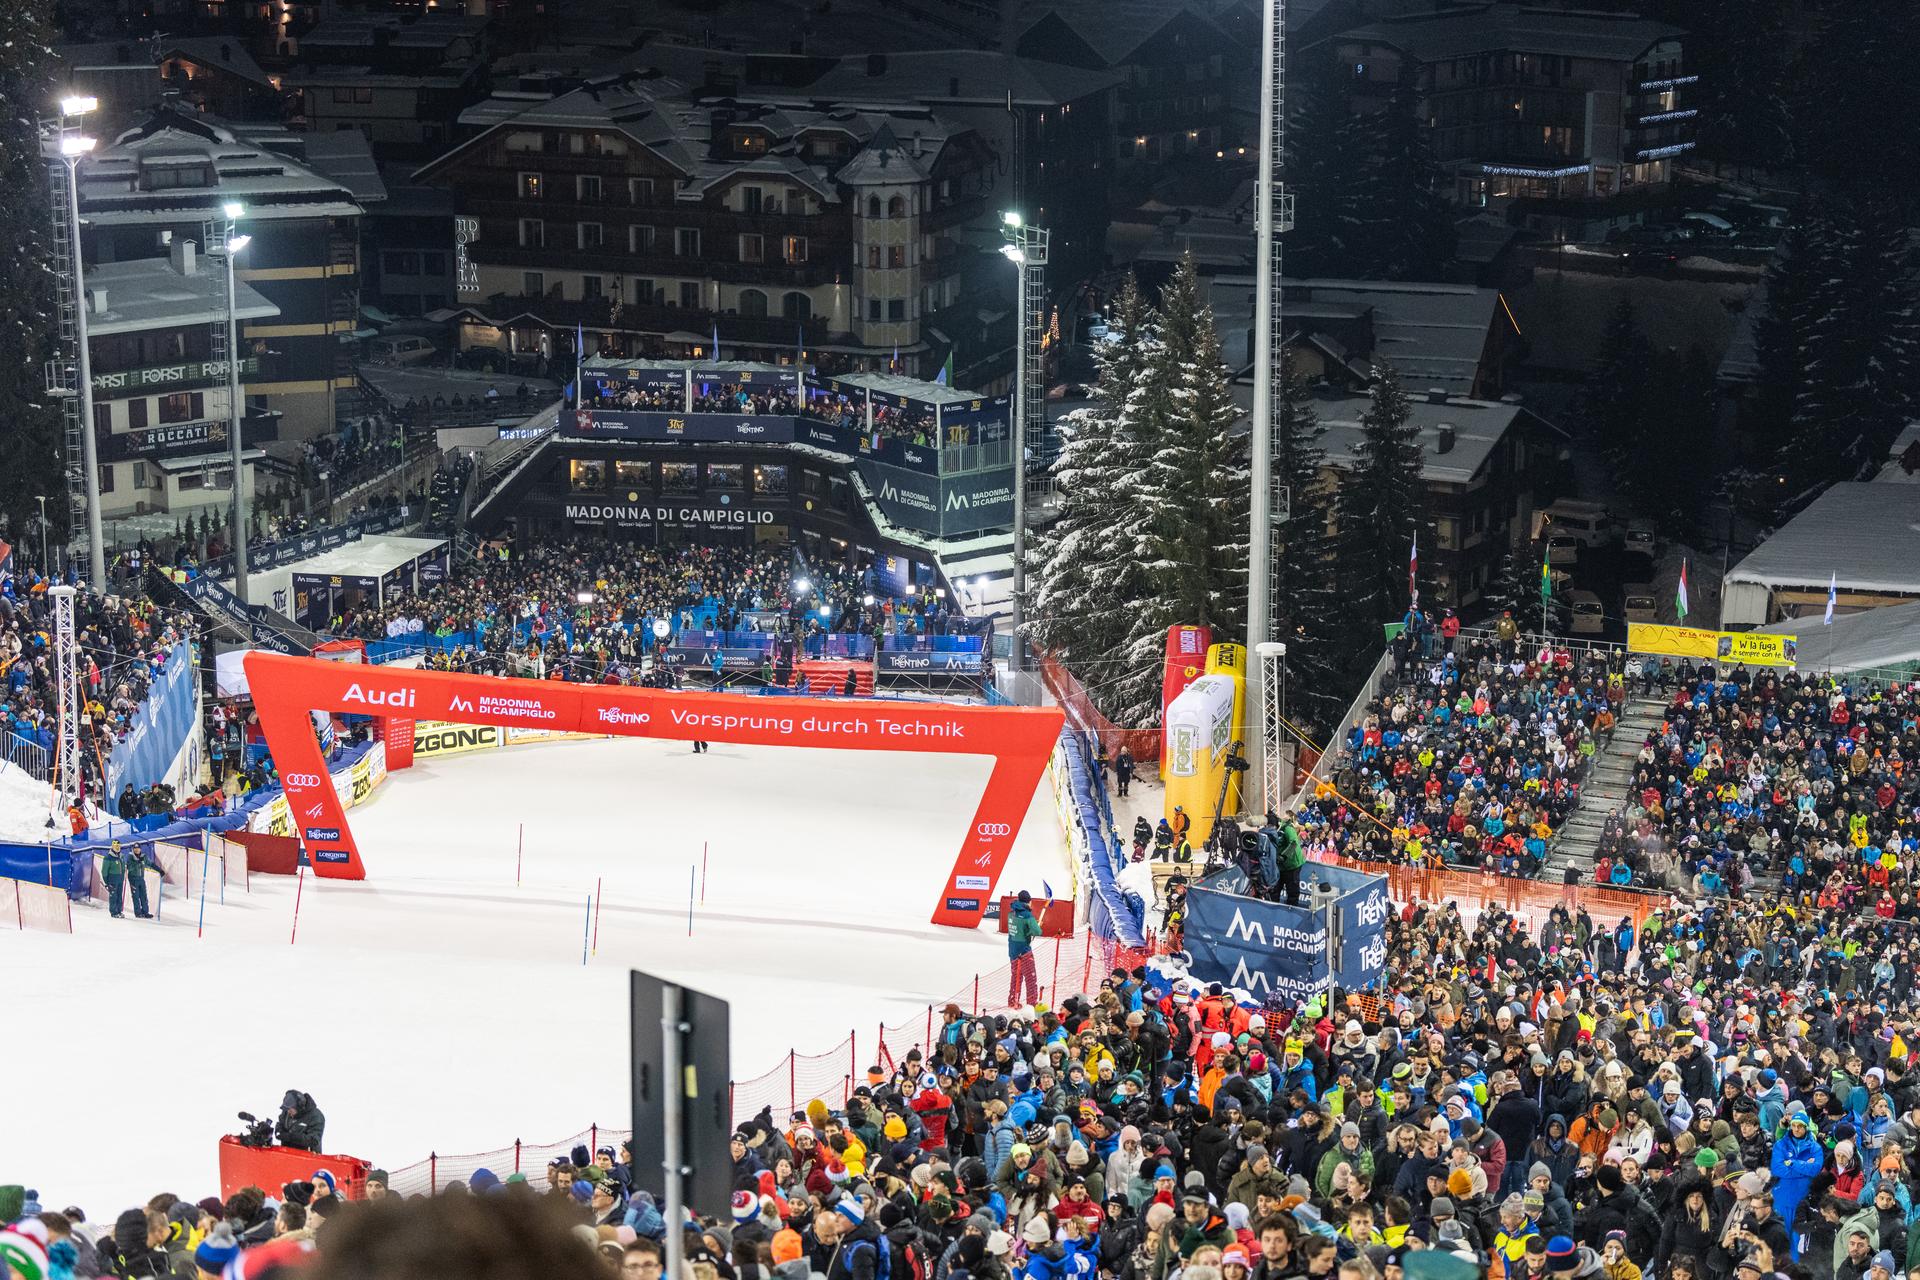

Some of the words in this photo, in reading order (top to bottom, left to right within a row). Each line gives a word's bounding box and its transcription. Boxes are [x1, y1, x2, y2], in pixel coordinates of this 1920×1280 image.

[456, 219, 467, 282] HOTEL
[91, 373, 127, 389] ORST
[142, 366, 186, 384] FORST
[147, 428, 208, 444] ROCCATI
[737, 423, 764, 434] TRENTINO
[901, 489, 930, 503] MADONNA
[972, 487, 1010, 500] MADONNA
[907, 499, 937, 512] CAMPIGLIO
[566, 506, 651, 520] MADONNA
[657, 508, 673, 520] DI
[679, 508, 774, 523] CAMPIGLIO
[255, 626, 289, 652] TRENTINO
[1750, 641, 1757, 650] la
[1759, 642, 1776, 652] fuga
[890, 655, 930, 668] TRENTINO
[342, 683, 416, 708] Audi
[479, 697, 542, 709] MADONNA
[479, 706, 490, 714] DI
[492, 707, 556, 719] CAMPIGLIO
[598, 707, 650, 724] TRENTINO
[671, 709, 793, 734] Vorsprung
[801, 717, 868, 734] durch
[876, 719, 964, 738] Technik
[414, 727, 496, 753] ZGONC
[1176, 728, 1191, 772] FORST
[307, 829, 338, 840] TRENTINO
[1356, 889, 1388, 927] TREN
[1273, 925, 1326, 943] MADONNA
[1273, 937, 1285, 948] DI
